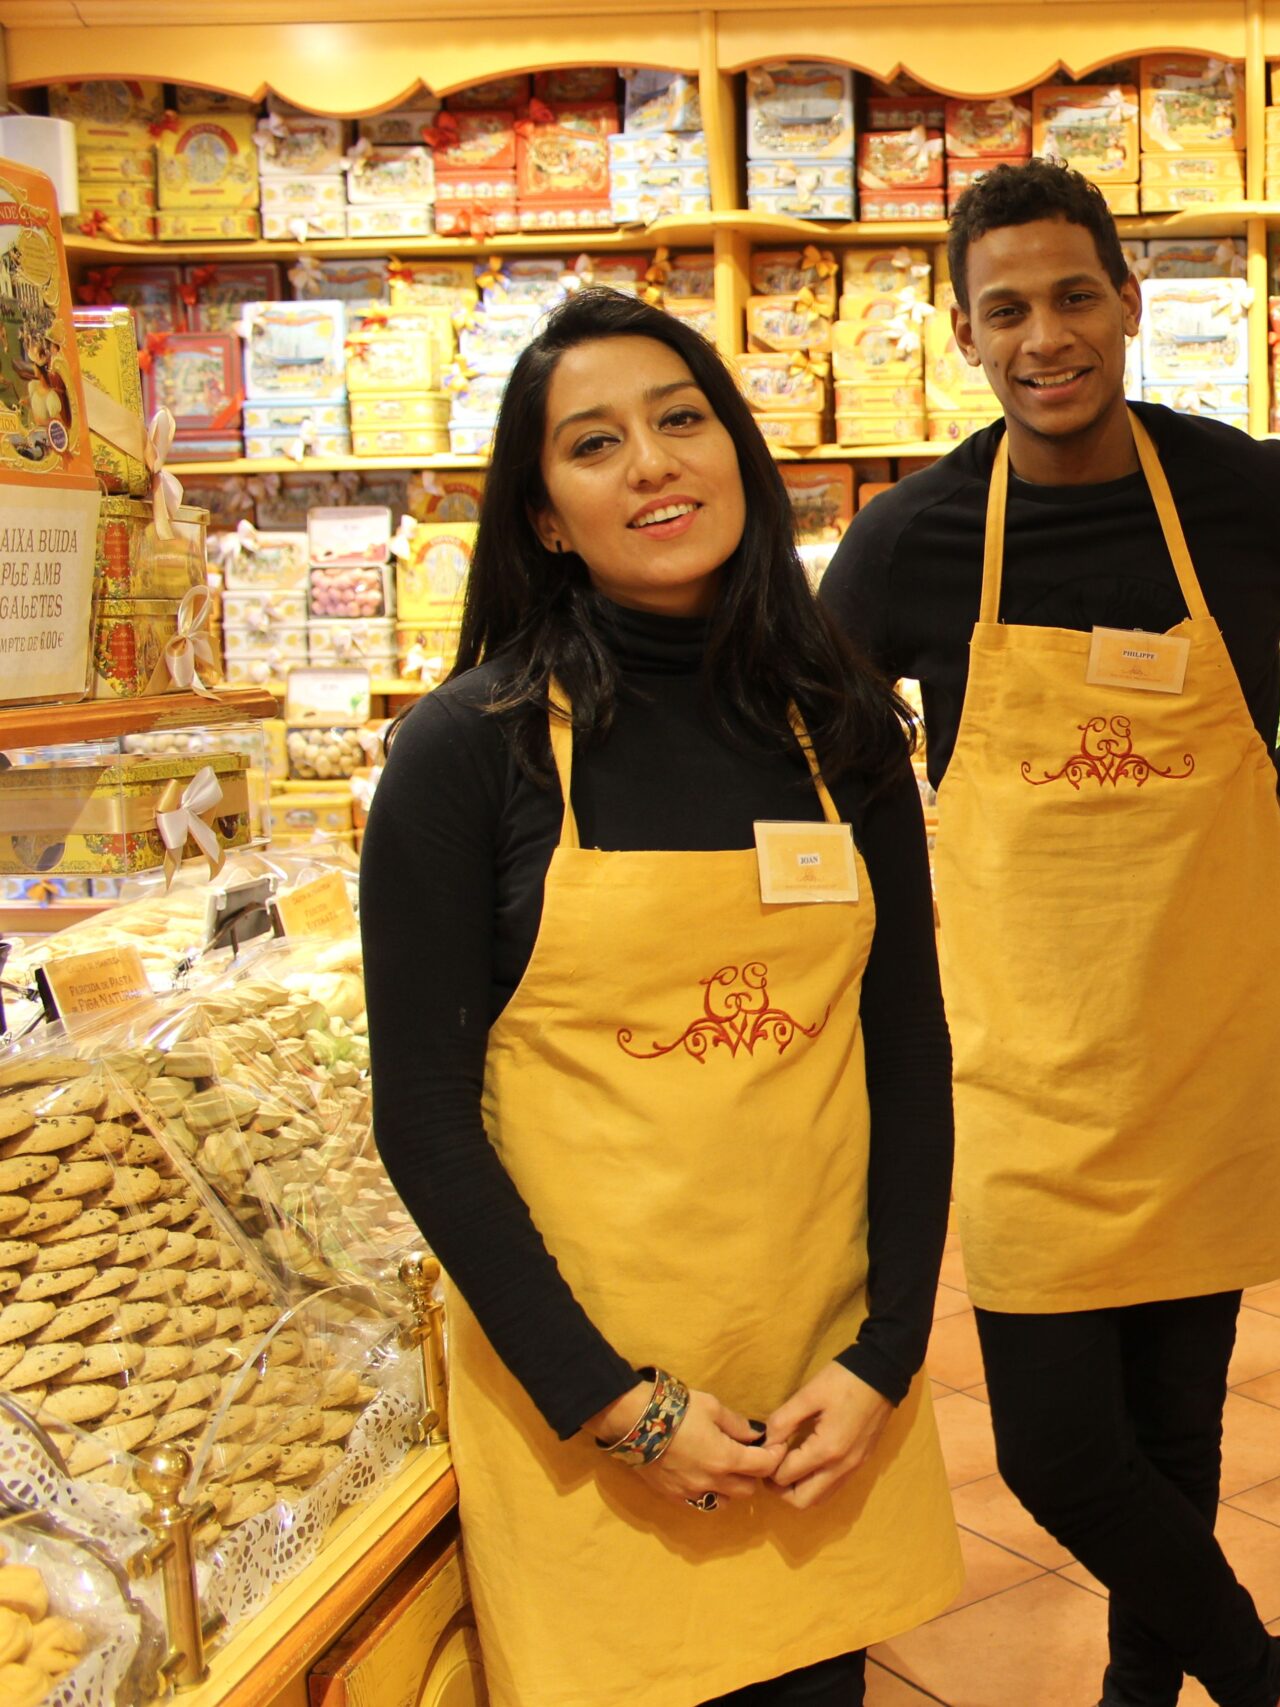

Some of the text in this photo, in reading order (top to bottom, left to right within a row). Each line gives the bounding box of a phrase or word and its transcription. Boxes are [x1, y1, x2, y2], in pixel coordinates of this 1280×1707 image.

[38, 529, 78, 553] BUIDA
[32, 562, 62, 586] AMB
[1122, 650, 1156, 660] PHILIPPE
[800, 855, 818, 865] JOAN
